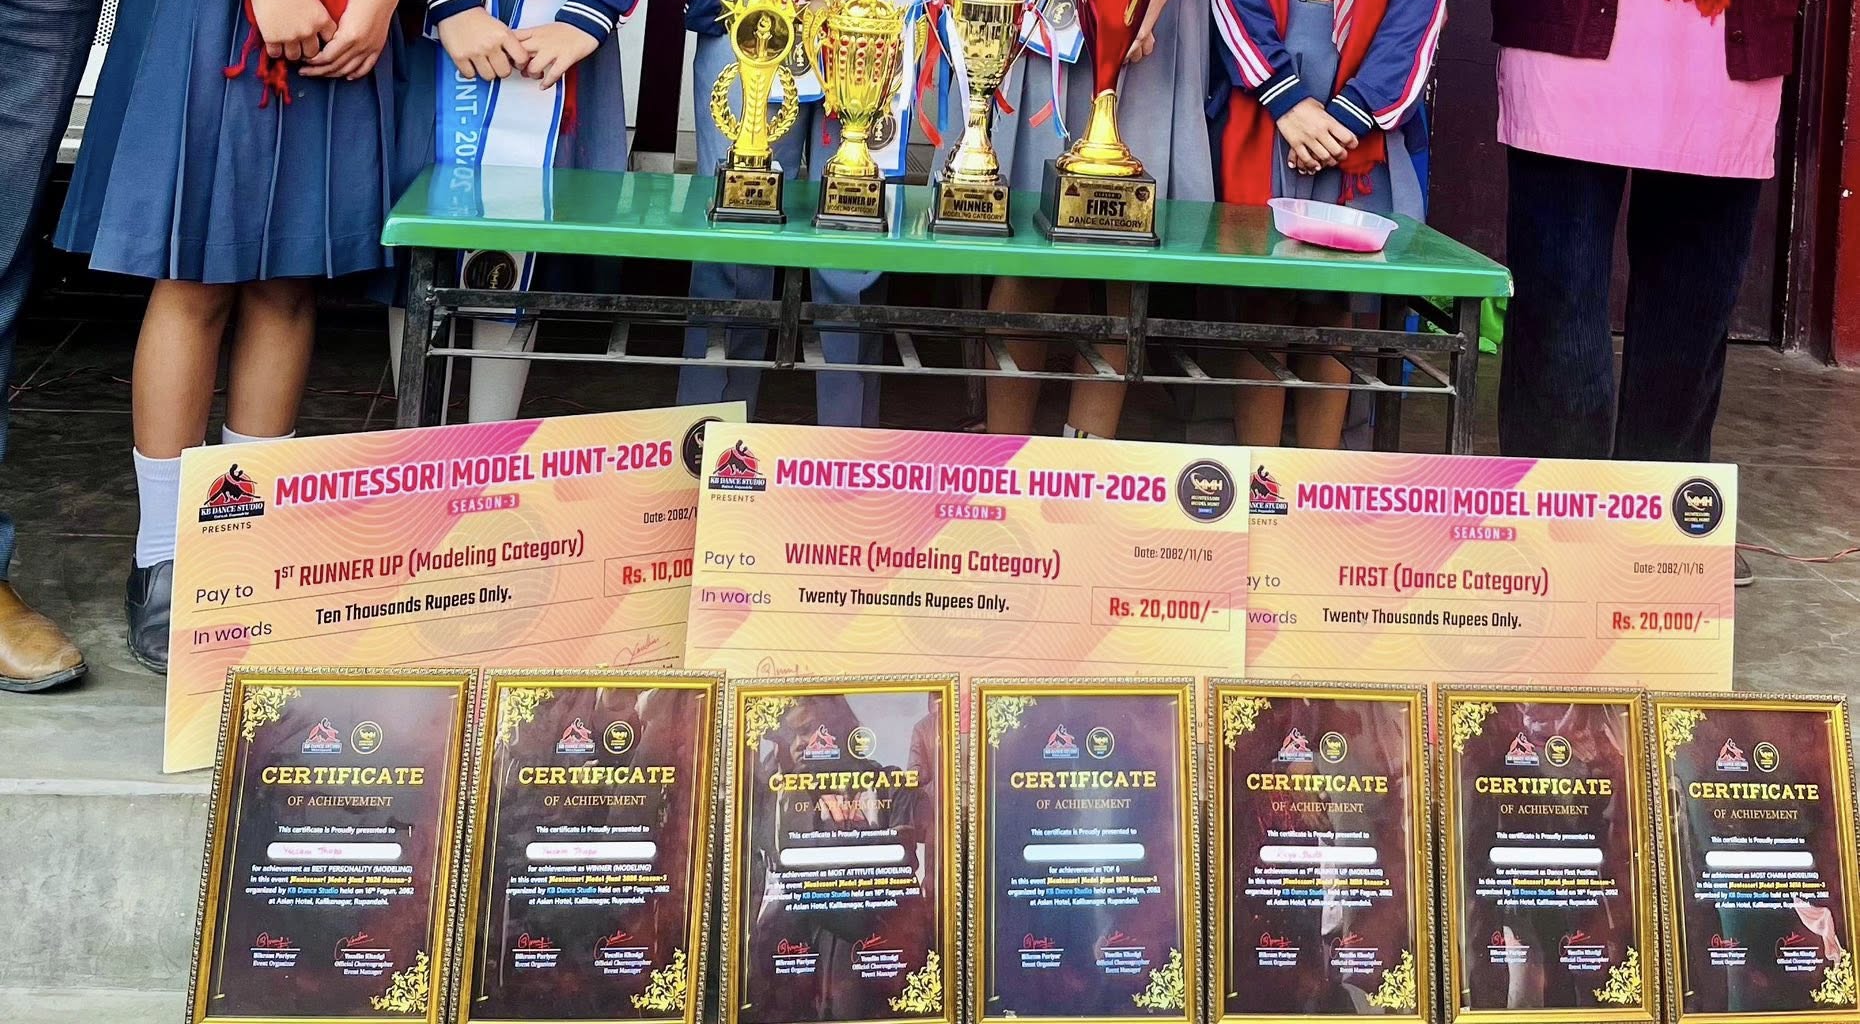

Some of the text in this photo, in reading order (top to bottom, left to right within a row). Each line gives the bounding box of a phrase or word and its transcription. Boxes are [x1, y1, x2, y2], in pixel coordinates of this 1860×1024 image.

[838, 195, 865, 205] RUNNER
[867, 197, 876, 206] UP
[954, 200, 993, 213] WINNER
[1087, 200, 1126, 217] FIRST
[1069, 216, 1142, 228] DANCE CATEGORY
[275, 440, 673, 506] MONTESSORI MODEL HUNT-2026
[777, 459, 1166, 502] MONTESSORI MODEL HUNT-2026
[452, 494, 516, 513] SEASON-3
[711, 494, 754, 502] PRESENTS
[1297, 484, 1663, 520] MONTESSORI MODEL HUNT-2026
[212, 506, 236, 514] DANCE
[237, 503, 263, 511] STUDIO
[643, 507, 698, 524] Date: 2082/1
[939, 505, 1003, 519] SEASON-3
[202, 522, 252, 534] PRESENTS
[1454, 527, 1513, 540] SEASON-3
[300, 558, 373, 587] RUNNER
[380, 555, 403, 577] UP
[408, 545, 496, 577] (Modeling
[502, 529, 584, 562] Category)
[705, 551, 755, 569] Pay to
[785, 541, 1061, 580] WINNER (Modeling Category)
[1134, 546, 1213, 562] Date: 2082/11/16
[623, 558, 692, 585] Rs. 10,00
[1634, 562, 1704, 575] Date: 2082/11/16
[1247, 575, 1280, 590] ay to
[1339, 563, 1549, 596] FIRST (Dance Category)
[196, 584, 254, 605] Pay to
[702, 589, 771, 604] In words
[799, 588, 1010, 612] Twenty Thousands Rupees Only.
[316, 585, 512, 625] Ten Thousands Rupees Only.
[1110, 598, 1218, 622] Rs. 20,000/-
[1249, 611, 1297, 624] words
[1323, 608, 1522, 630] Twenty Thousands Rupees Only.
[1613, 611, 1710, 632] Rs. 20,000/-
[194, 621, 272, 645] In words
[261, 766, 425, 785] CERTIFICATE
[518, 767, 675, 785] CERTIFICATE
[768, 770, 918, 791] CERTIFICATE
[1011, 771, 1157, 788] CERTIFICATE
[1247, 773, 1388, 792] CERTIFICATE
[1475, 777, 1612, 795] CERTIFICATE
[1689, 782, 1819, 800] CERTIFICATE
[288, 796, 393, 807] OF ACHIEVEMENT
[544, 795, 647, 806] OF ACHIEVEMENT
[795, 802, 809, 812] OF
[1036, 799, 1131, 809] OF ACHIEVEMENT
[1272, 802, 1363, 813] OF ACHIEVEMENT
[1501, 804, 1589, 815] OF ACHIEVEMENT
[1714, 809, 1798, 820] OF ACHIEVEMENT
[279, 826, 291, 834] This
